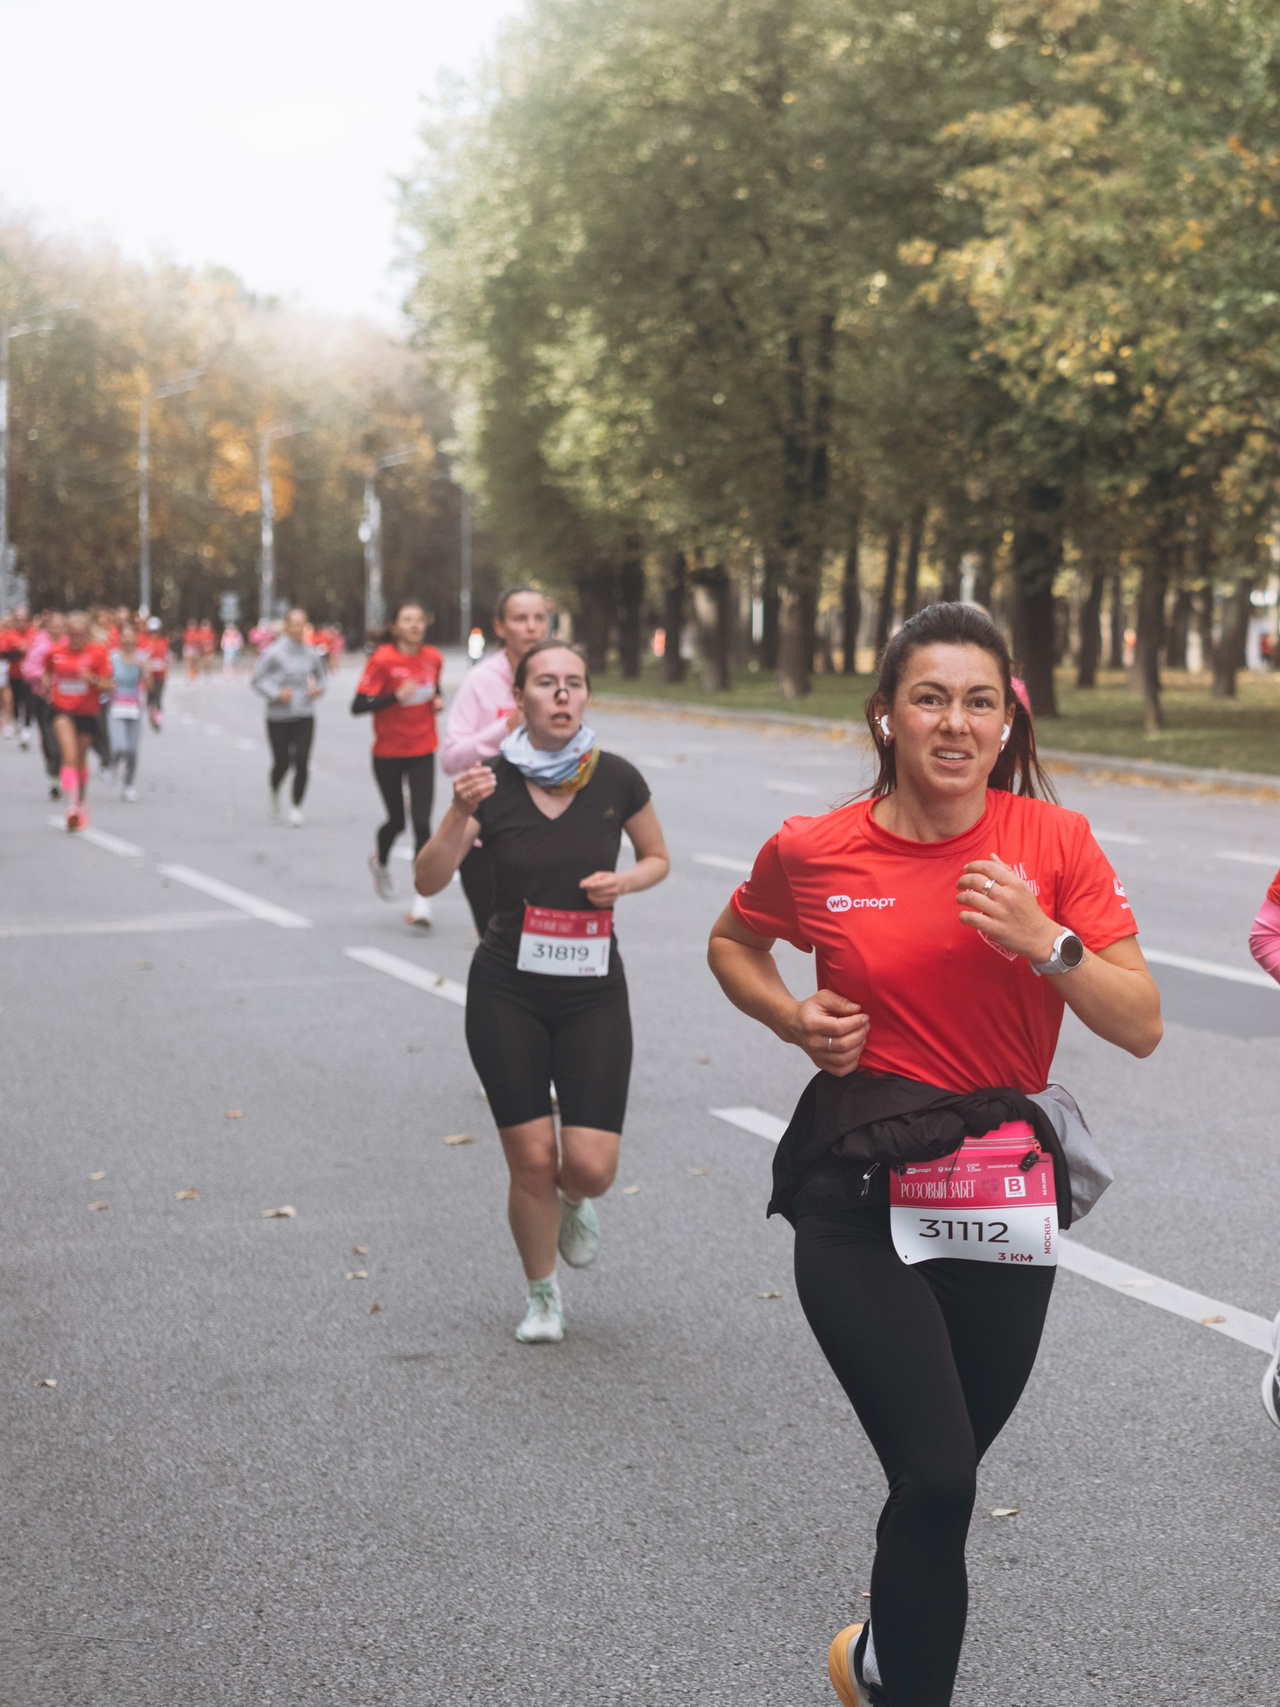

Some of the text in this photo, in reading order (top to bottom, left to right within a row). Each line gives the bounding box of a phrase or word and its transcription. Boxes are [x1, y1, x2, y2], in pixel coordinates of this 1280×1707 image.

[853, 898, 896, 909] спорт
[532, 944, 589, 962] 31819
[901, 1179, 976, 1199] РОЗОВЫЙ ЗАБЕГ
[1008, 1178, 1022, 1193] B
[919, 1218, 1010, 1243] 31112
[1044, 1216, 1052, 1254] МОСКВА
[998, 1252, 1007, 1261] 3
